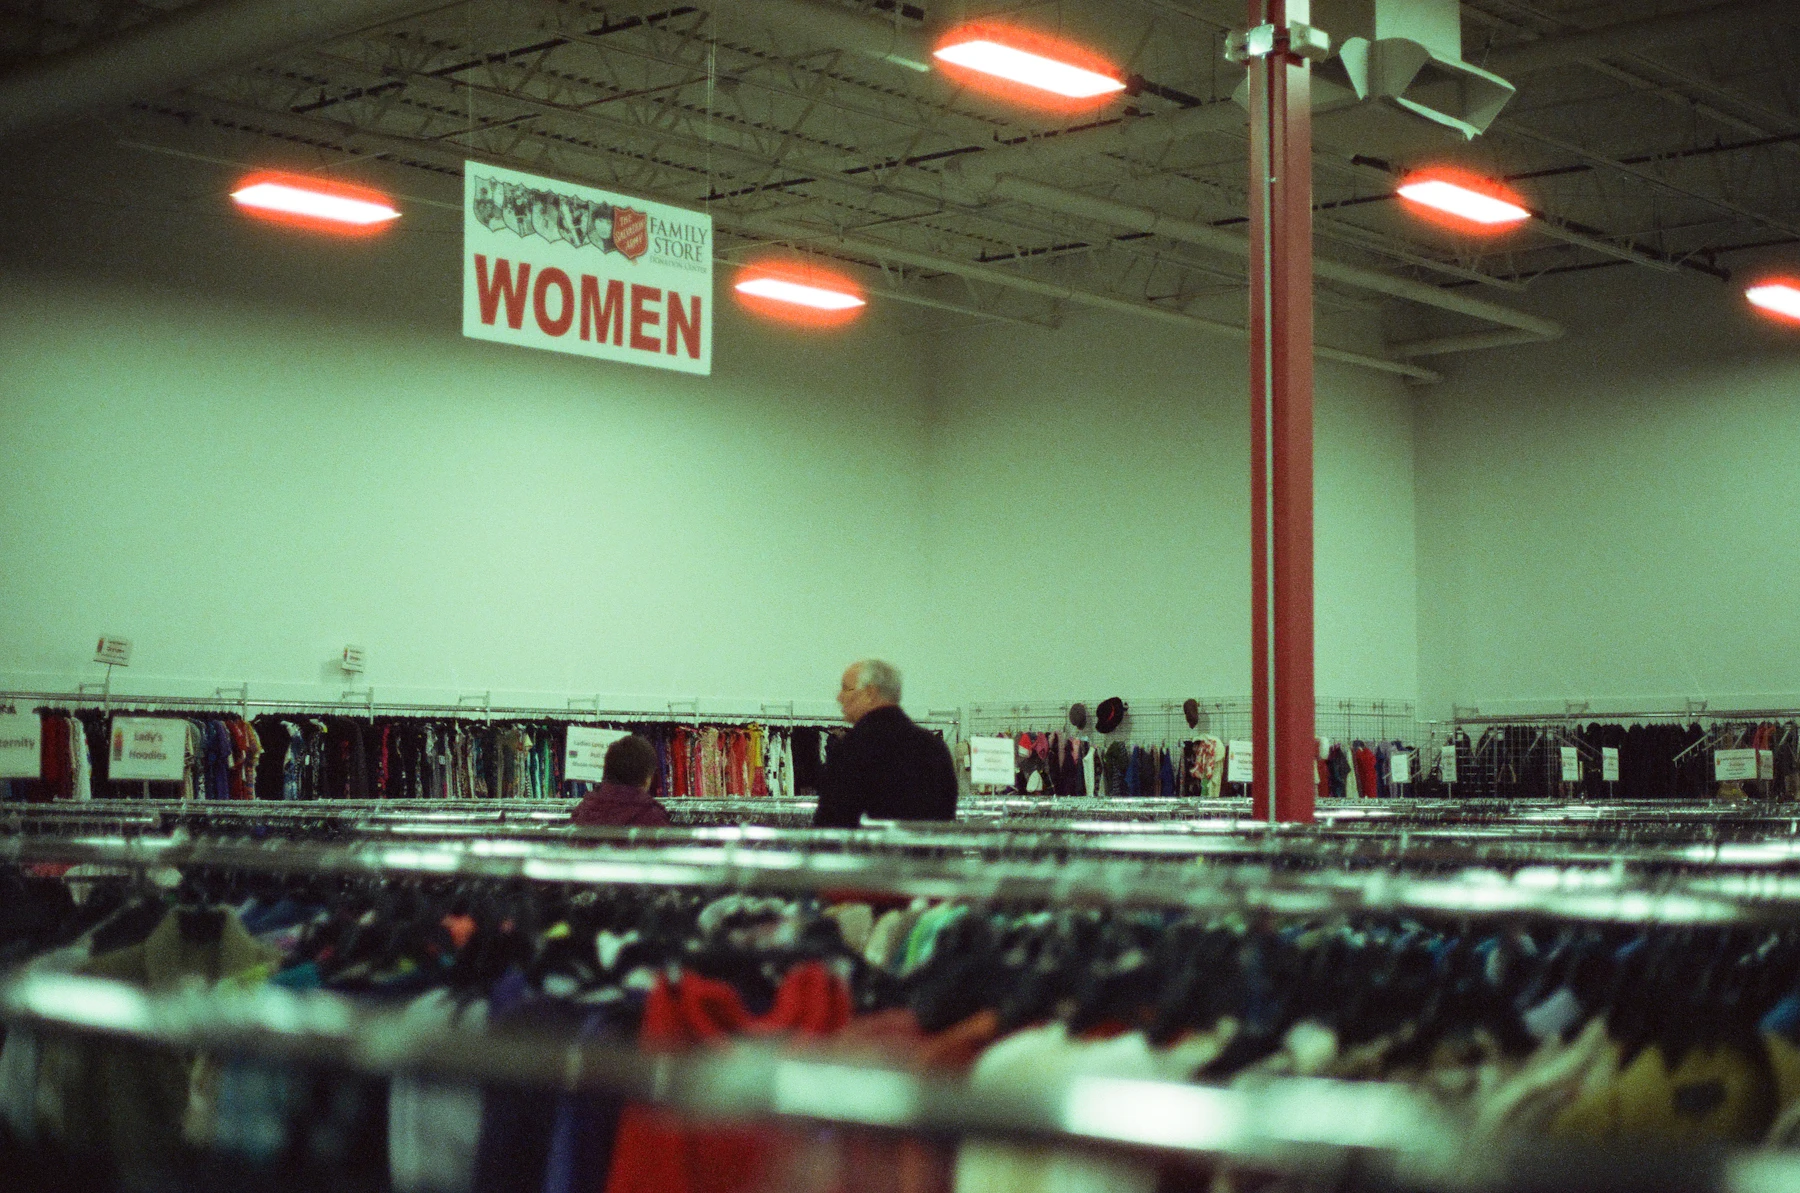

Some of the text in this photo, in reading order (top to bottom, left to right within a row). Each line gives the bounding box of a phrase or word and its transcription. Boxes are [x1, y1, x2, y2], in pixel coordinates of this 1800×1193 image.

[649, 217, 707, 244] FAMILY
[654, 237, 702, 262] STORE
[474, 253, 702, 360] WOMEN
